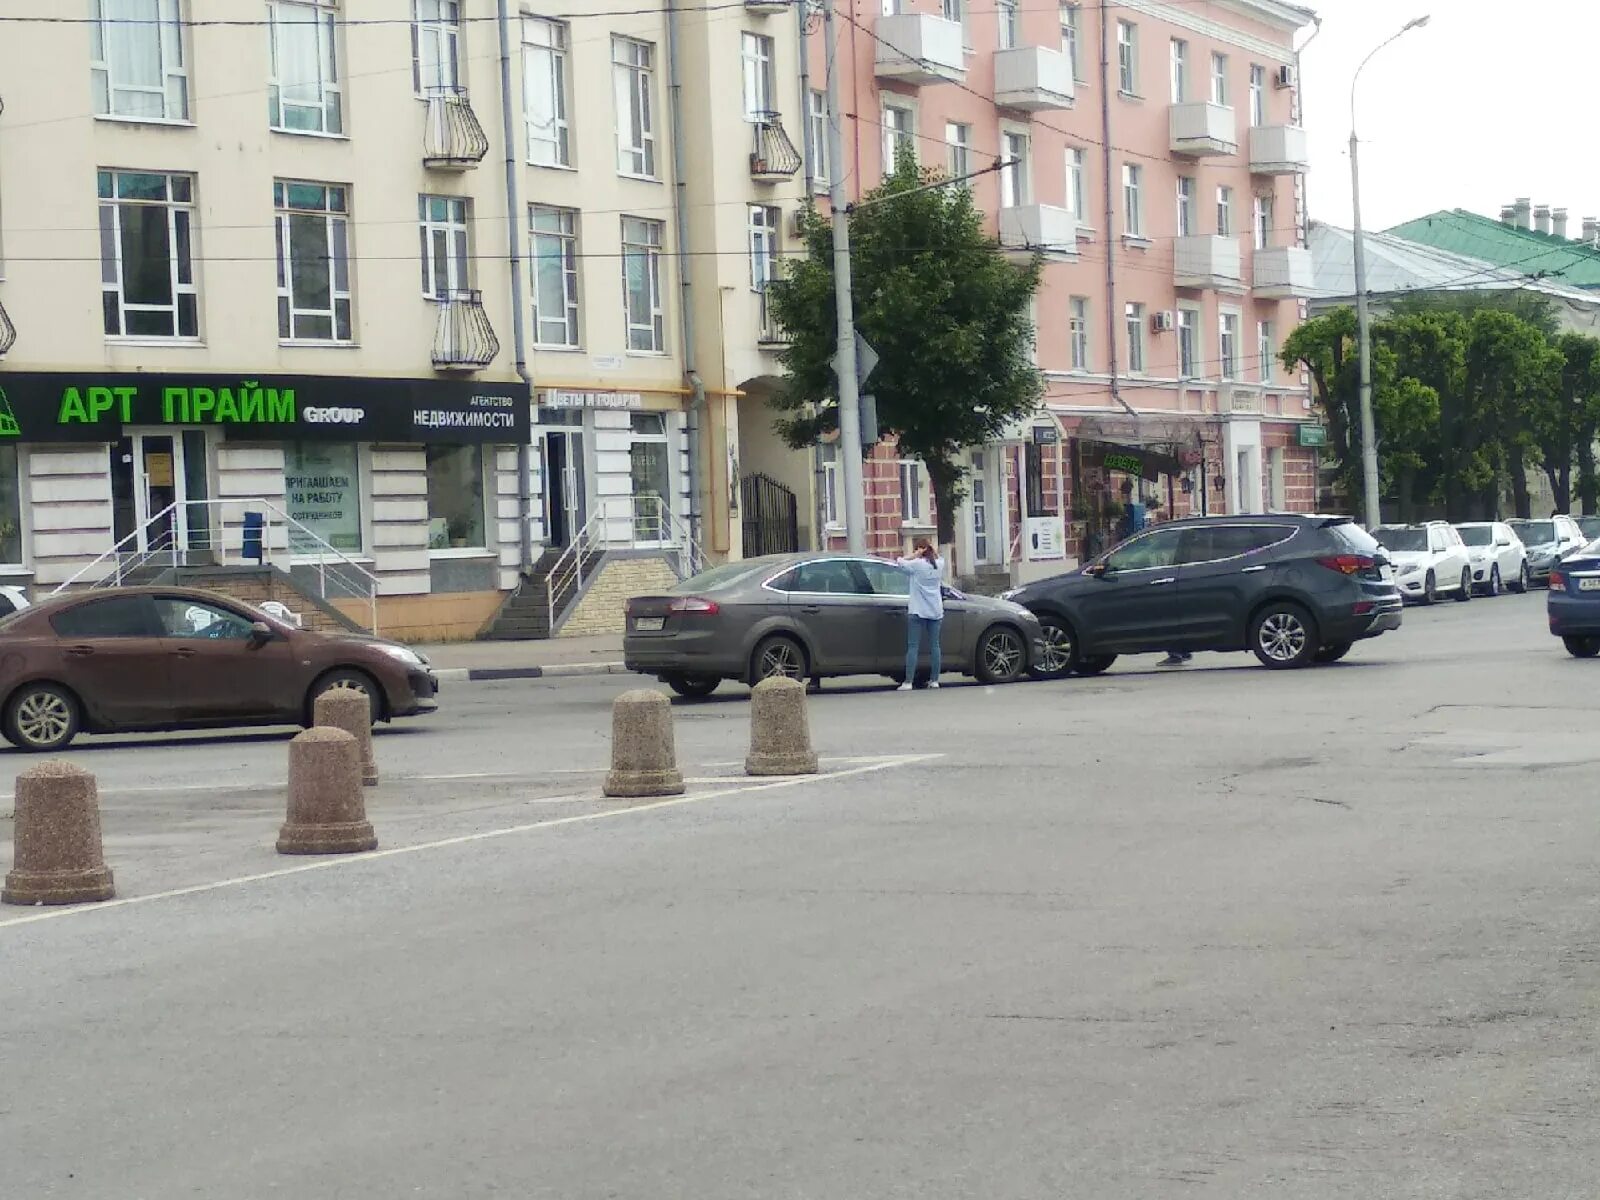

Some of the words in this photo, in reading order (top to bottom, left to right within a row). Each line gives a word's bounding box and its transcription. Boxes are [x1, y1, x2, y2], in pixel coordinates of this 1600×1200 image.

[58, 386, 138, 423] АРТ
[162, 380, 296, 423] ПРАЙМ
[470, 395, 513, 407] АГЕНТСТВО
[302, 406, 365, 424] GROUP
[413, 409, 515, 428] НЕДВИЖИМОСТИ
[291, 493, 305, 504] НА
[307, 492, 343, 504] РАБОТУ
